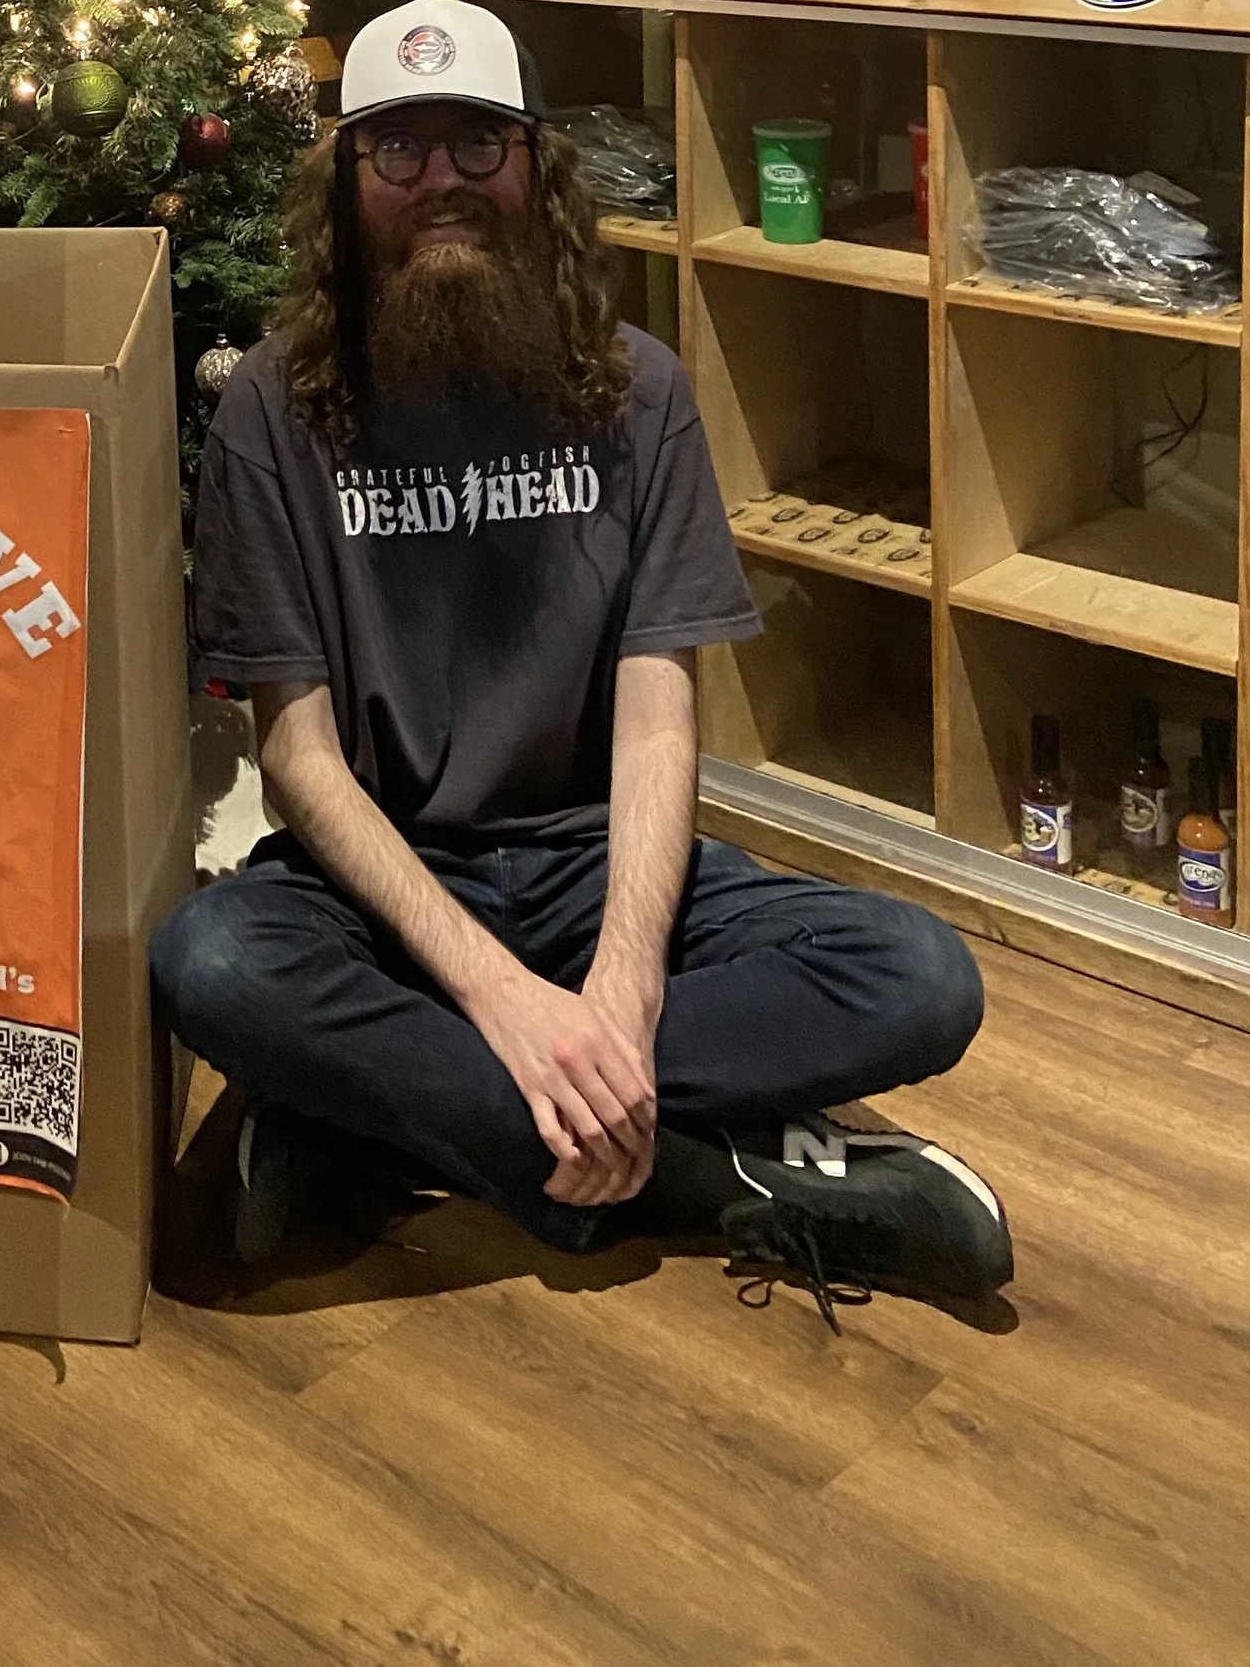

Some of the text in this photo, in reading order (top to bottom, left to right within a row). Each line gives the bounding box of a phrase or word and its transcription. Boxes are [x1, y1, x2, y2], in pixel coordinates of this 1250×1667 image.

[764, 192, 791, 204] Local
[336, 467, 447, 488] GRATEFUL
[338, 464, 600, 537] DEAD HEAD
